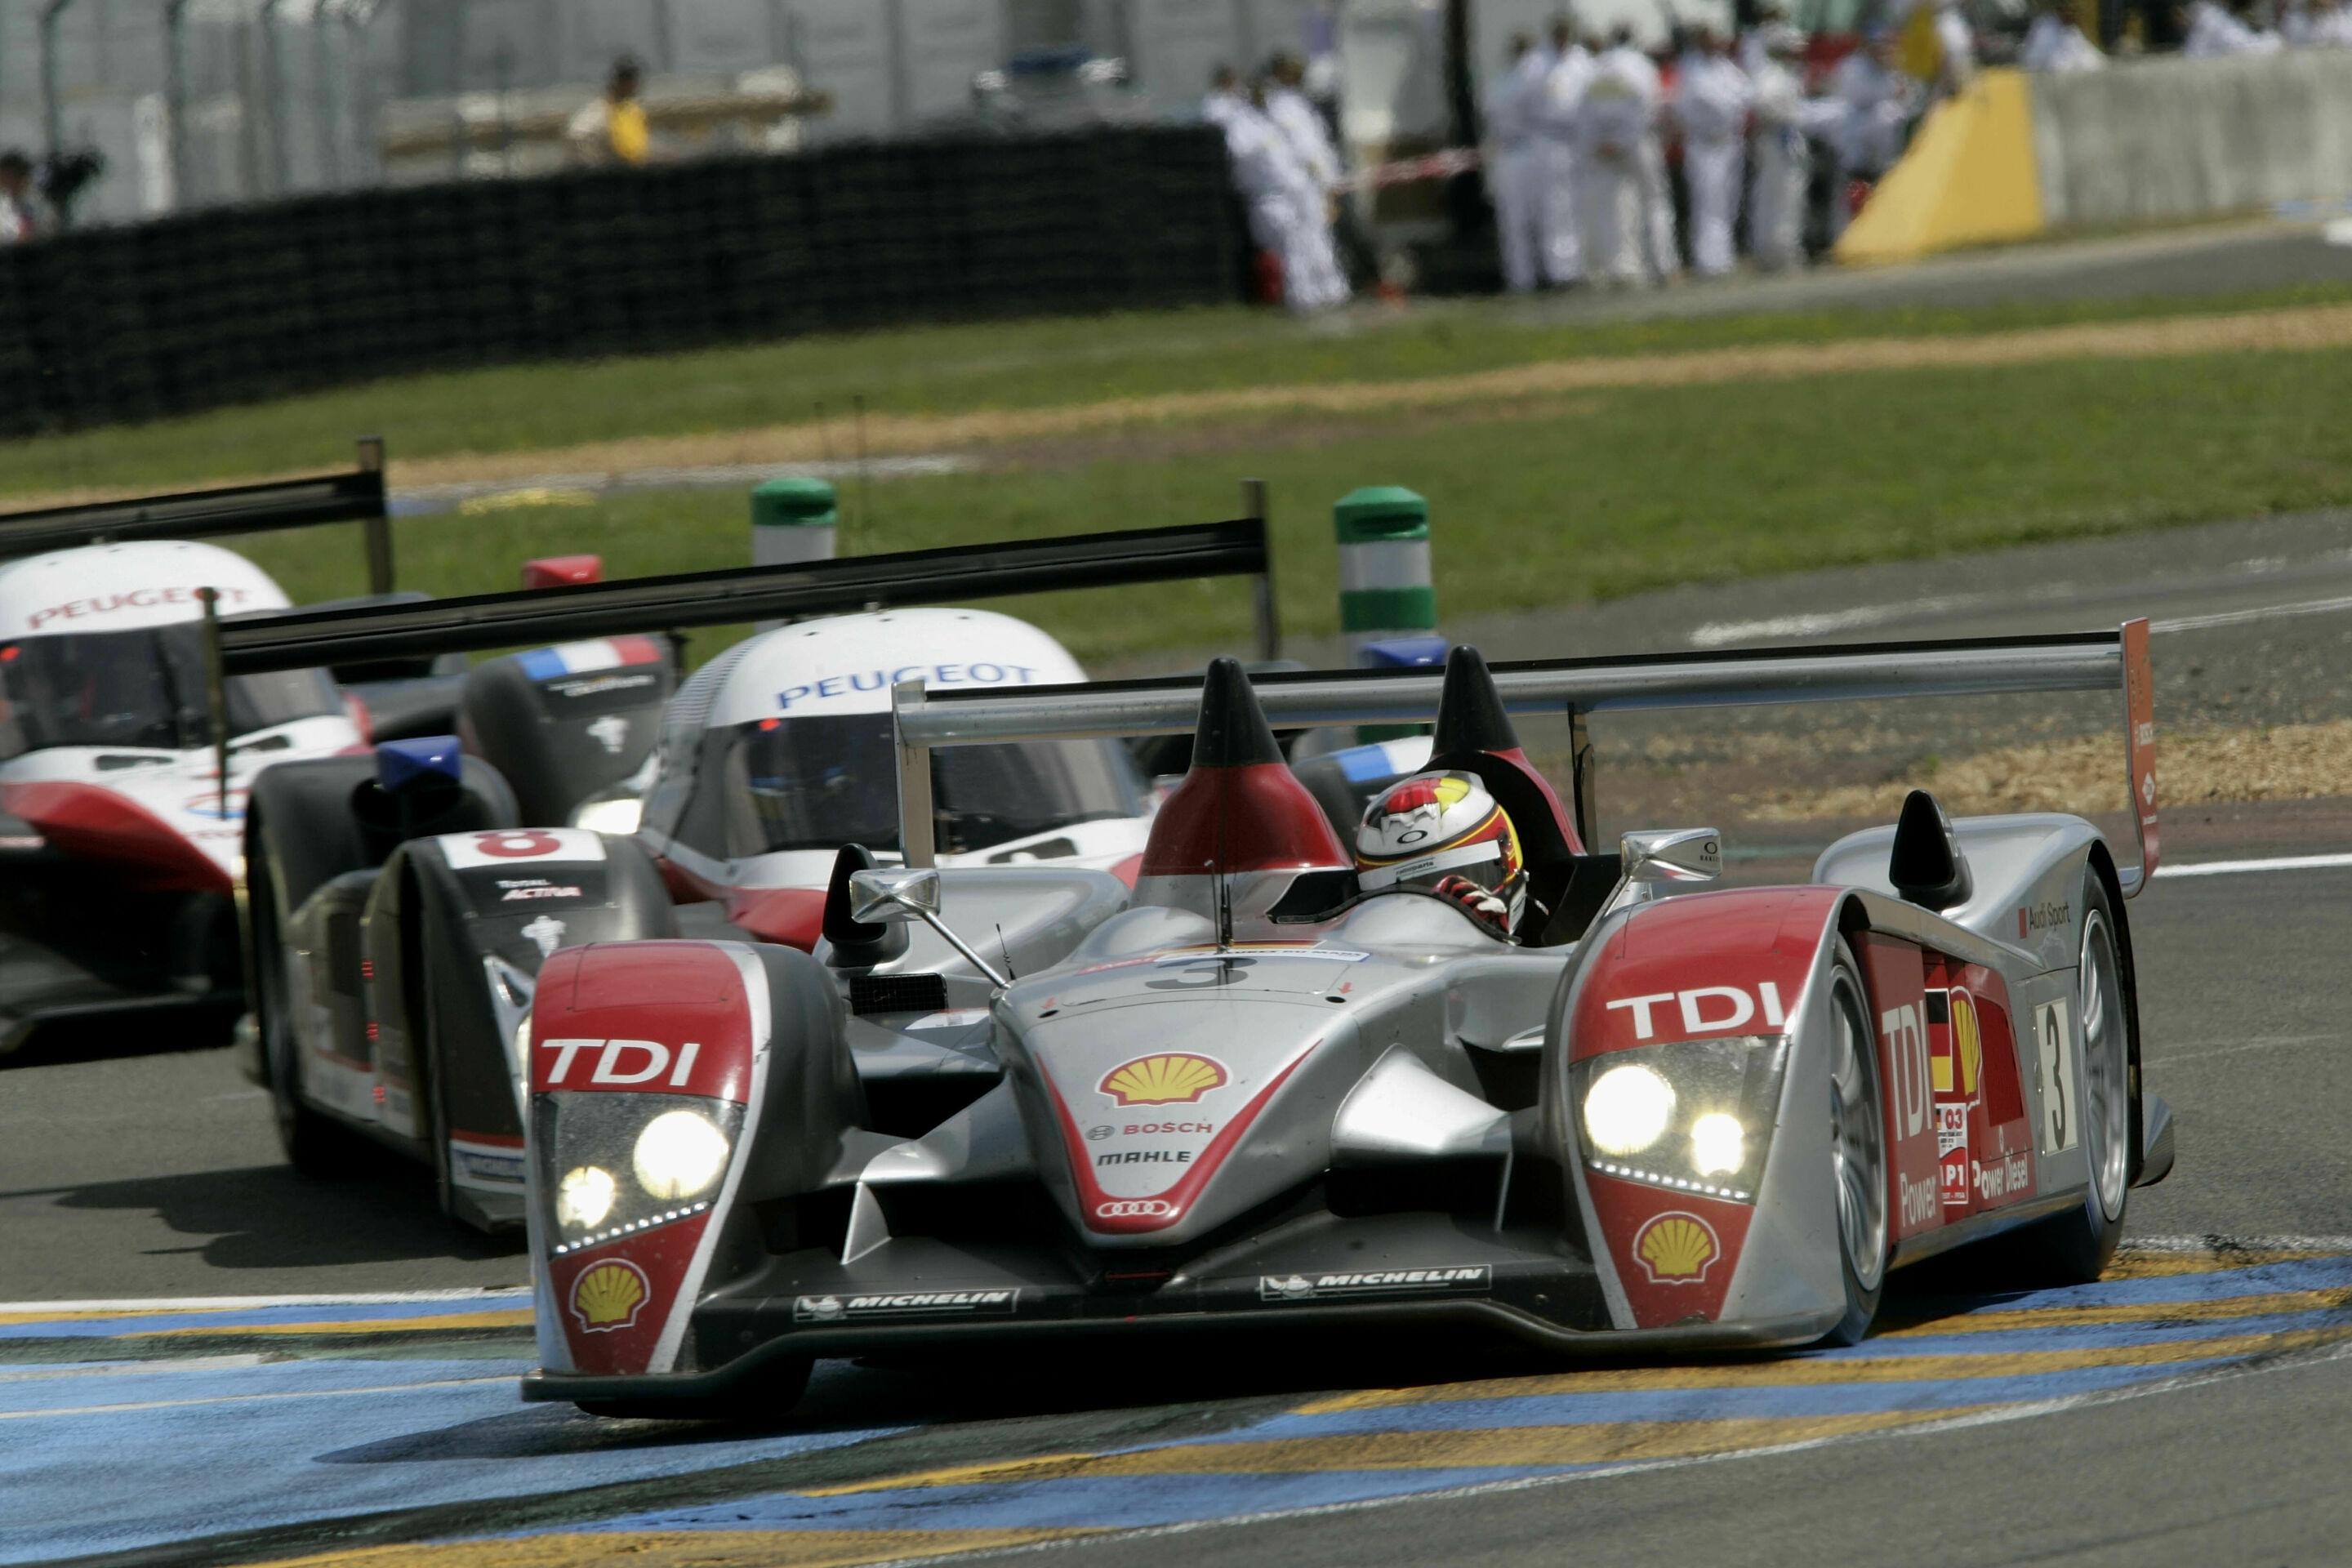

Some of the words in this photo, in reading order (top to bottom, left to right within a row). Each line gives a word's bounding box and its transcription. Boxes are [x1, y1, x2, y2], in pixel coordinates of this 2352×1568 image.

[27, 587, 249, 629] PEUGEOT
[777, 662, 1038, 709] PEUGEOT
[474, 831, 562, 858] 8
[2029, 902, 2046, 931] Audi
[2047, 902, 2071, 931] Sport
[1144, 957, 1258, 989] 3
[1606, 982, 1785, 1040] TDI
[541, 1039, 701, 1086] TDI
[1882, 1000, 1932, 1142] TDI
[2047, 1004, 2066, 1151] 3
[1122, 1121, 1213, 1135] BOSCH
[1945, 1108, 1963, 1129] 03
[1097, 1152, 1192, 1166] MAHLE
[1971, 1160, 2003, 1200] Power
[2005, 1143, 2029, 1192] Diesel
[1939, 1165, 1964, 1186] P1
[1900, 1173, 1936, 1227] Power
[1317, 1268, 1484, 1286] MICHELIN
[847, 1292, 1009, 1307] MICHELIN
